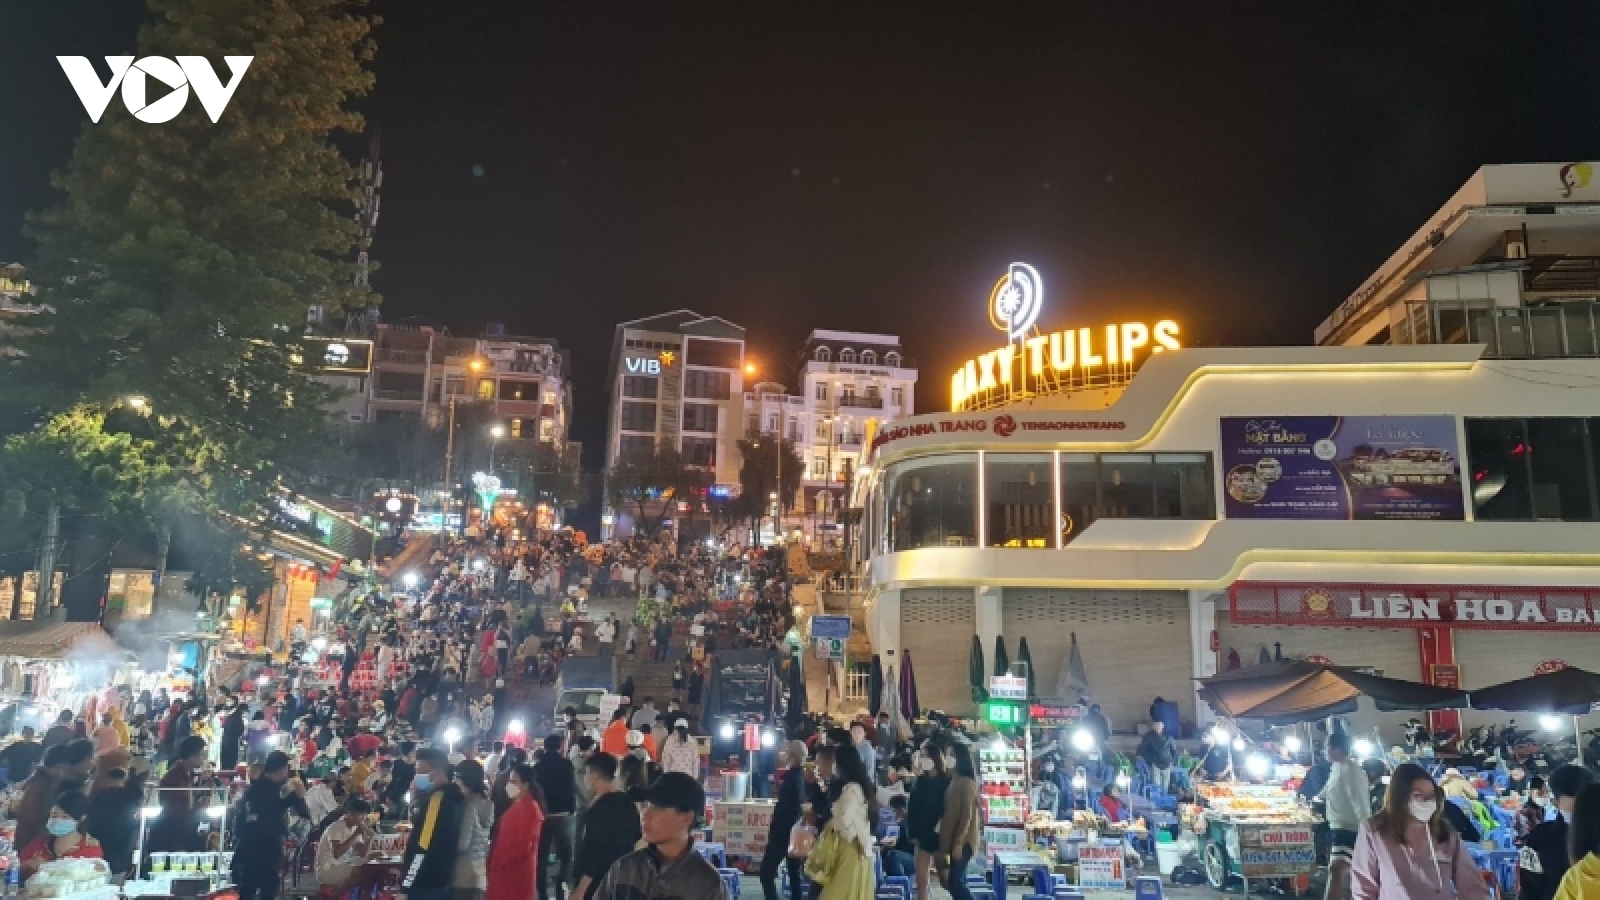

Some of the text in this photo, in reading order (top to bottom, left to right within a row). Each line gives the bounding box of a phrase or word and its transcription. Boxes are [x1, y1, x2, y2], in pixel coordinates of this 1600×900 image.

[1026, 320, 1181, 377] TULIPS
[625, 357, 661, 374] VIB
[940, 419, 987, 433] TRANG
[1350, 594, 1441, 620] LIÊN
[1455, 598, 1547, 622] HOA
